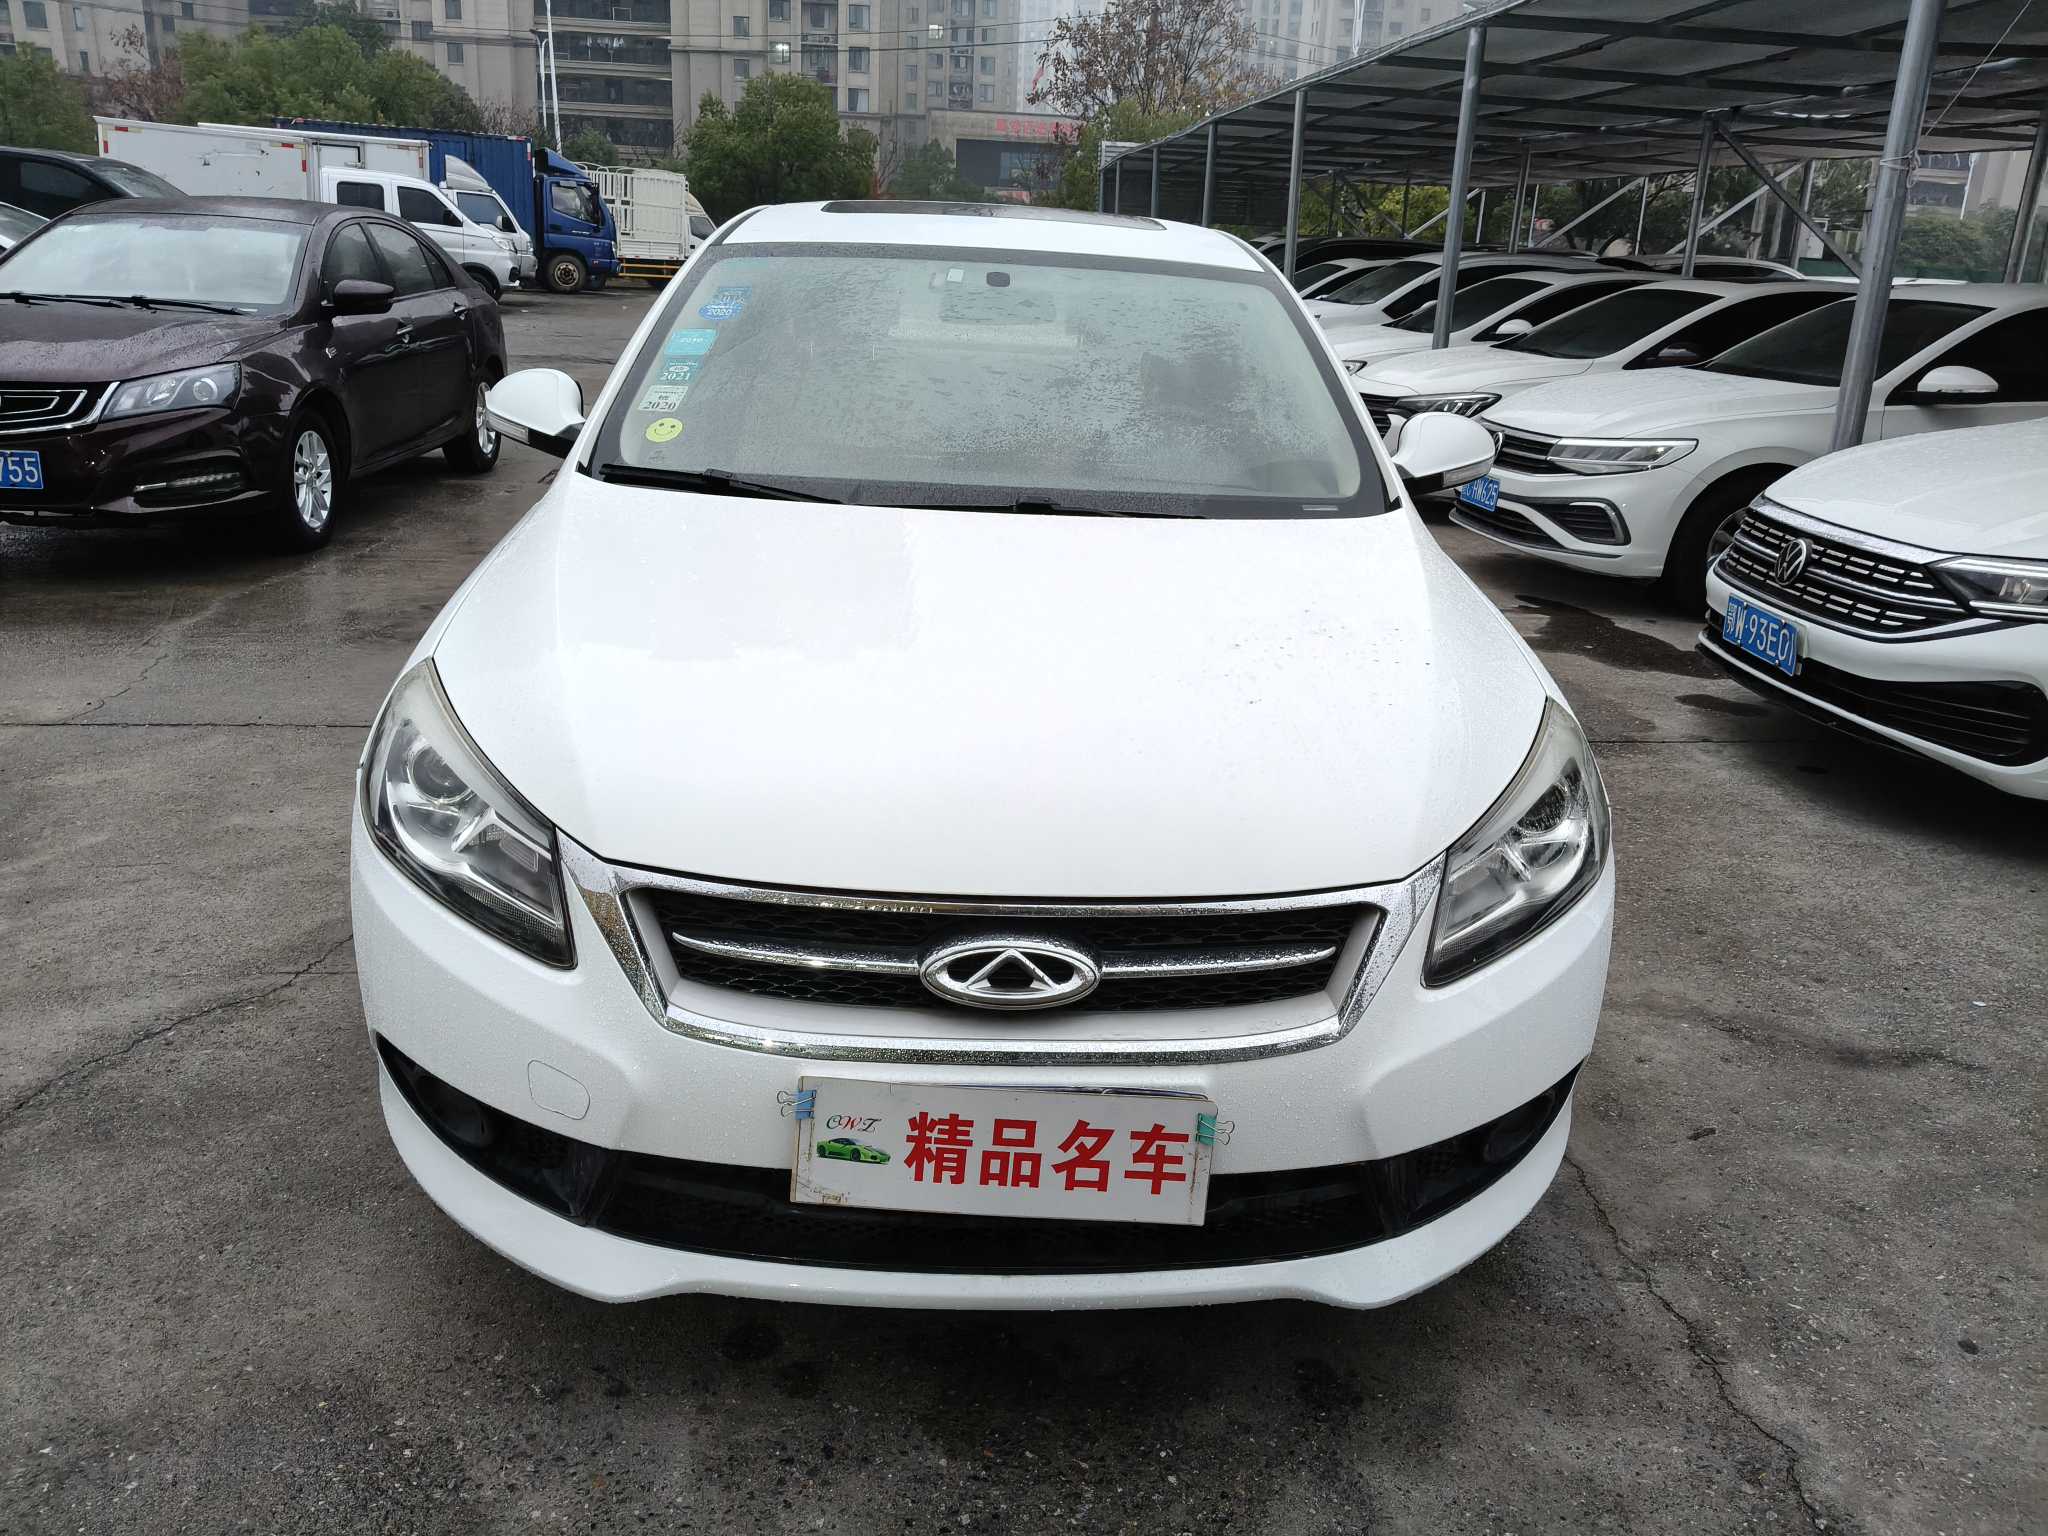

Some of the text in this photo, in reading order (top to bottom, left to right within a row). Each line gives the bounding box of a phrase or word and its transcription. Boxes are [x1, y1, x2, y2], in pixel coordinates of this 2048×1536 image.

[660, 372, 691, 381] 2021
[643, 401, 677, 410] 2020
[904, 1111, 1189, 1195] 精品名车
